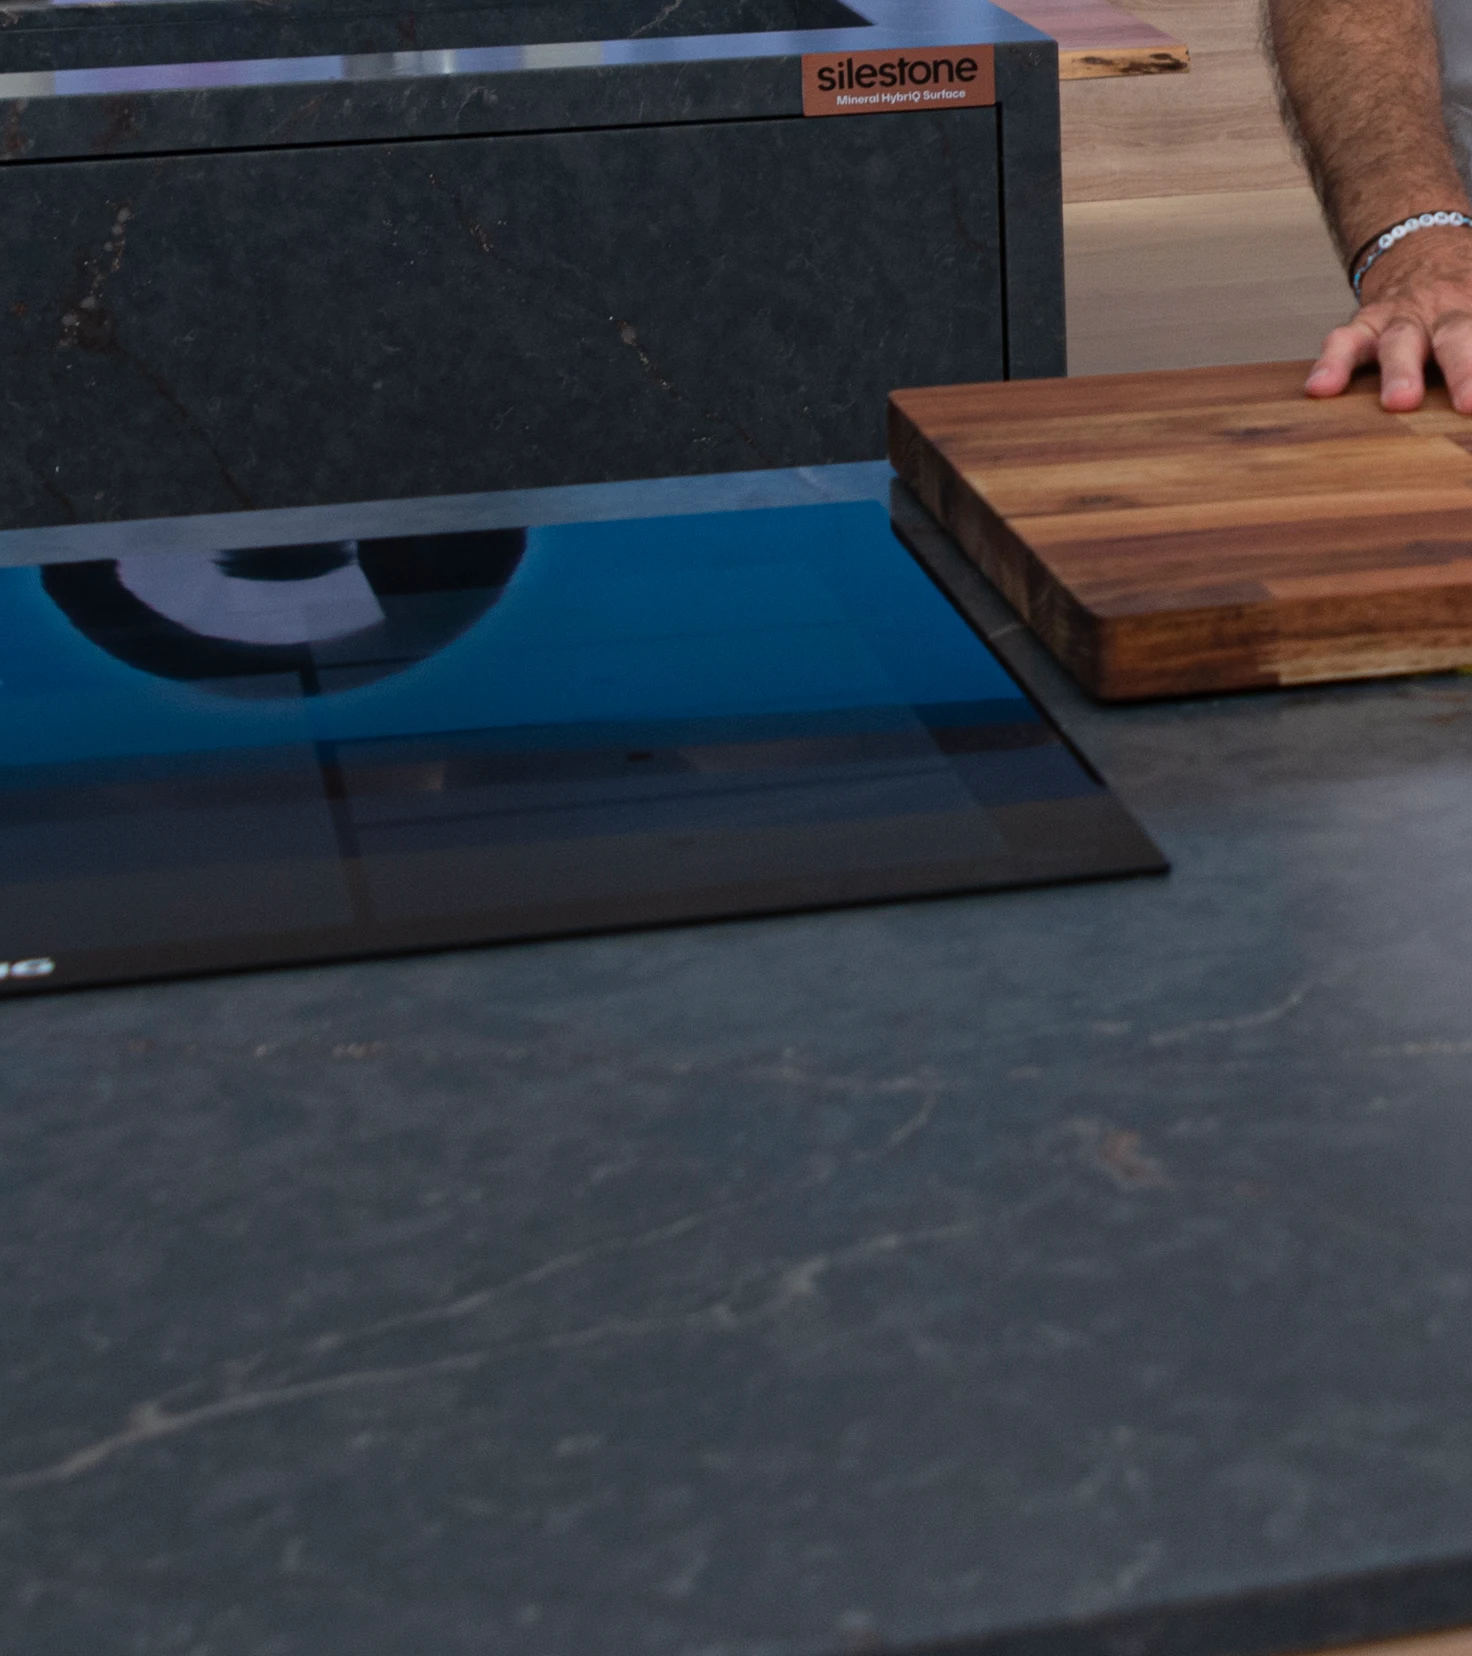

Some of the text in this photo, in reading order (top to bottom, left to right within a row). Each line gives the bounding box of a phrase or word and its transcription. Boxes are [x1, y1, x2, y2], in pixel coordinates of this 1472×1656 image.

[817, 57, 978, 92] silestone
[836, 94, 879, 106] Mineral
[923, 90, 966, 101] Surface
